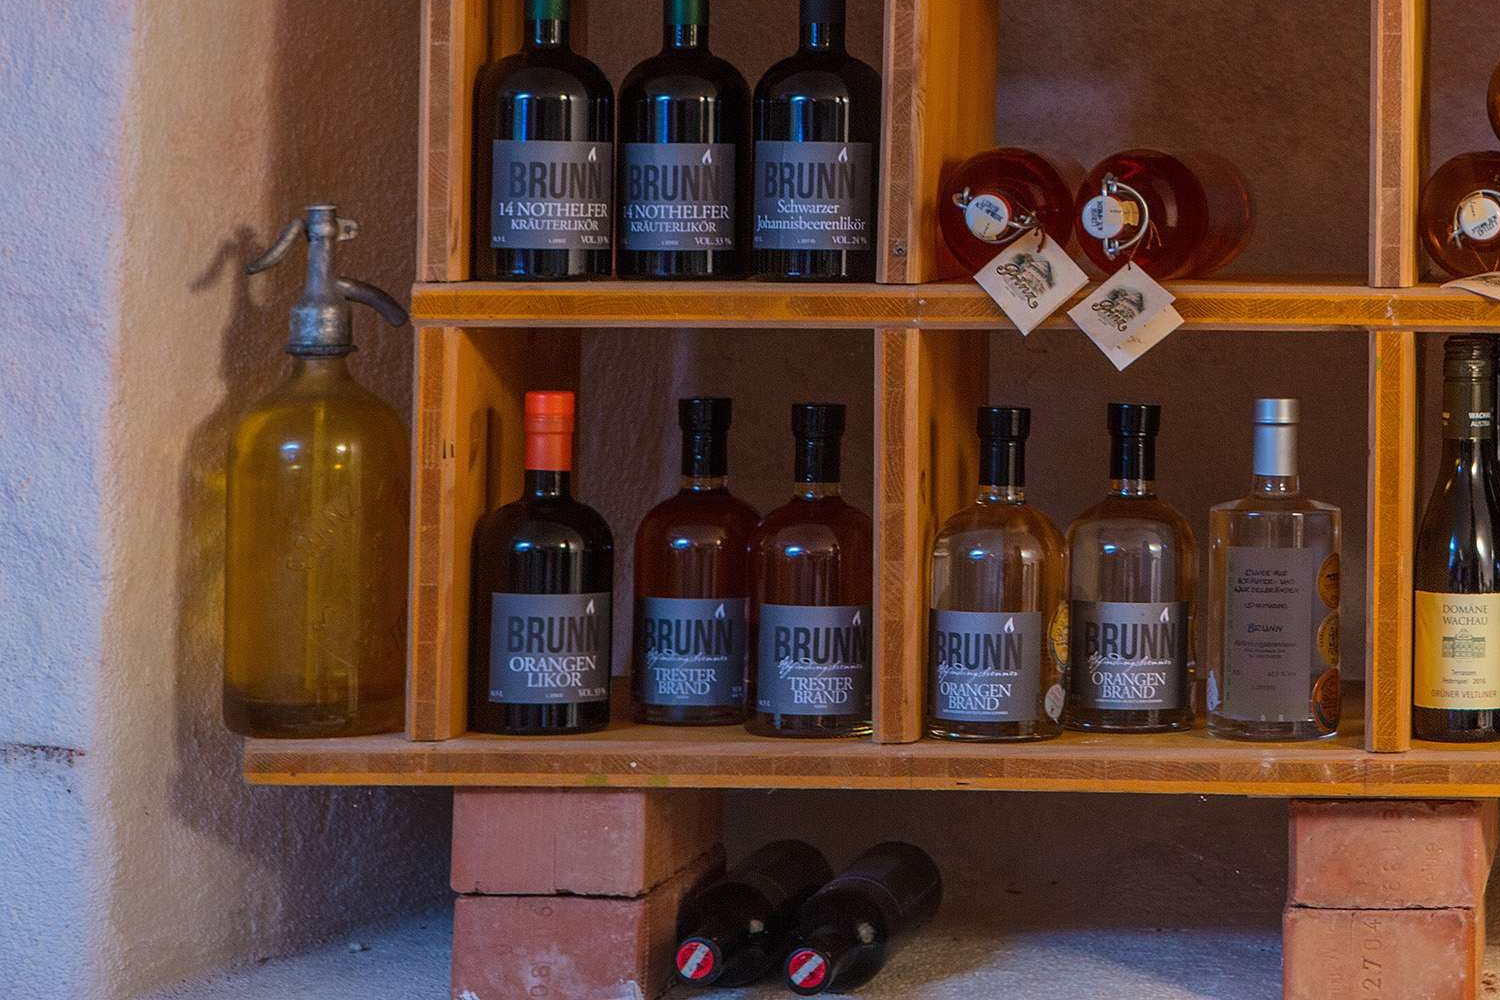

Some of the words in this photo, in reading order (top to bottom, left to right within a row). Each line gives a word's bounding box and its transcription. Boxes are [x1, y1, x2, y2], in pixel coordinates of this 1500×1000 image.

[508, 161, 602, 200] BRUNN
[629, 164, 721, 202] BRUNN
[764, 161, 857, 200] BRUNN
[499, 201, 514, 217] 14
[516, 201, 609, 218] NOTHELFER
[634, 203, 730, 220] NOTHELFER
[776, 198, 841, 214] Schwarzer
[510, 216, 601, 232] KRÄUTERLIKÖR
[630, 219, 718, 234] KRÄUTERLIKÖR
[756, 214, 867, 233] Johannisbeerenlikör
[1442, 603, 1489, 614] DOMÄNE
[1442, 615, 1489, 626] WACHAU
[507, 615, 600, 654] BRUNN
[644, 618, 733, 656] BRUNN
[1084, 621, 1177, 661] BRUNN
[773, 626, 868, 665] BRUNN
[935, 630, 1023, 671] BRUNN
[509, 655, 597, 673] ORANGEN
[654, 667, 718, 683] TRESTER
[1090, 671, 1168, 686] ORANGEN
[657, 681, 712, 696] BRAND
[787, 677, 855, 691] TRESTER
[940, 681, 1013, 698] ORANGEN
[1101, 685, 1157, 699] BRAND
[793, 690, 849, 705] BRAND
[948, 695, 1001, 711] BRAND
